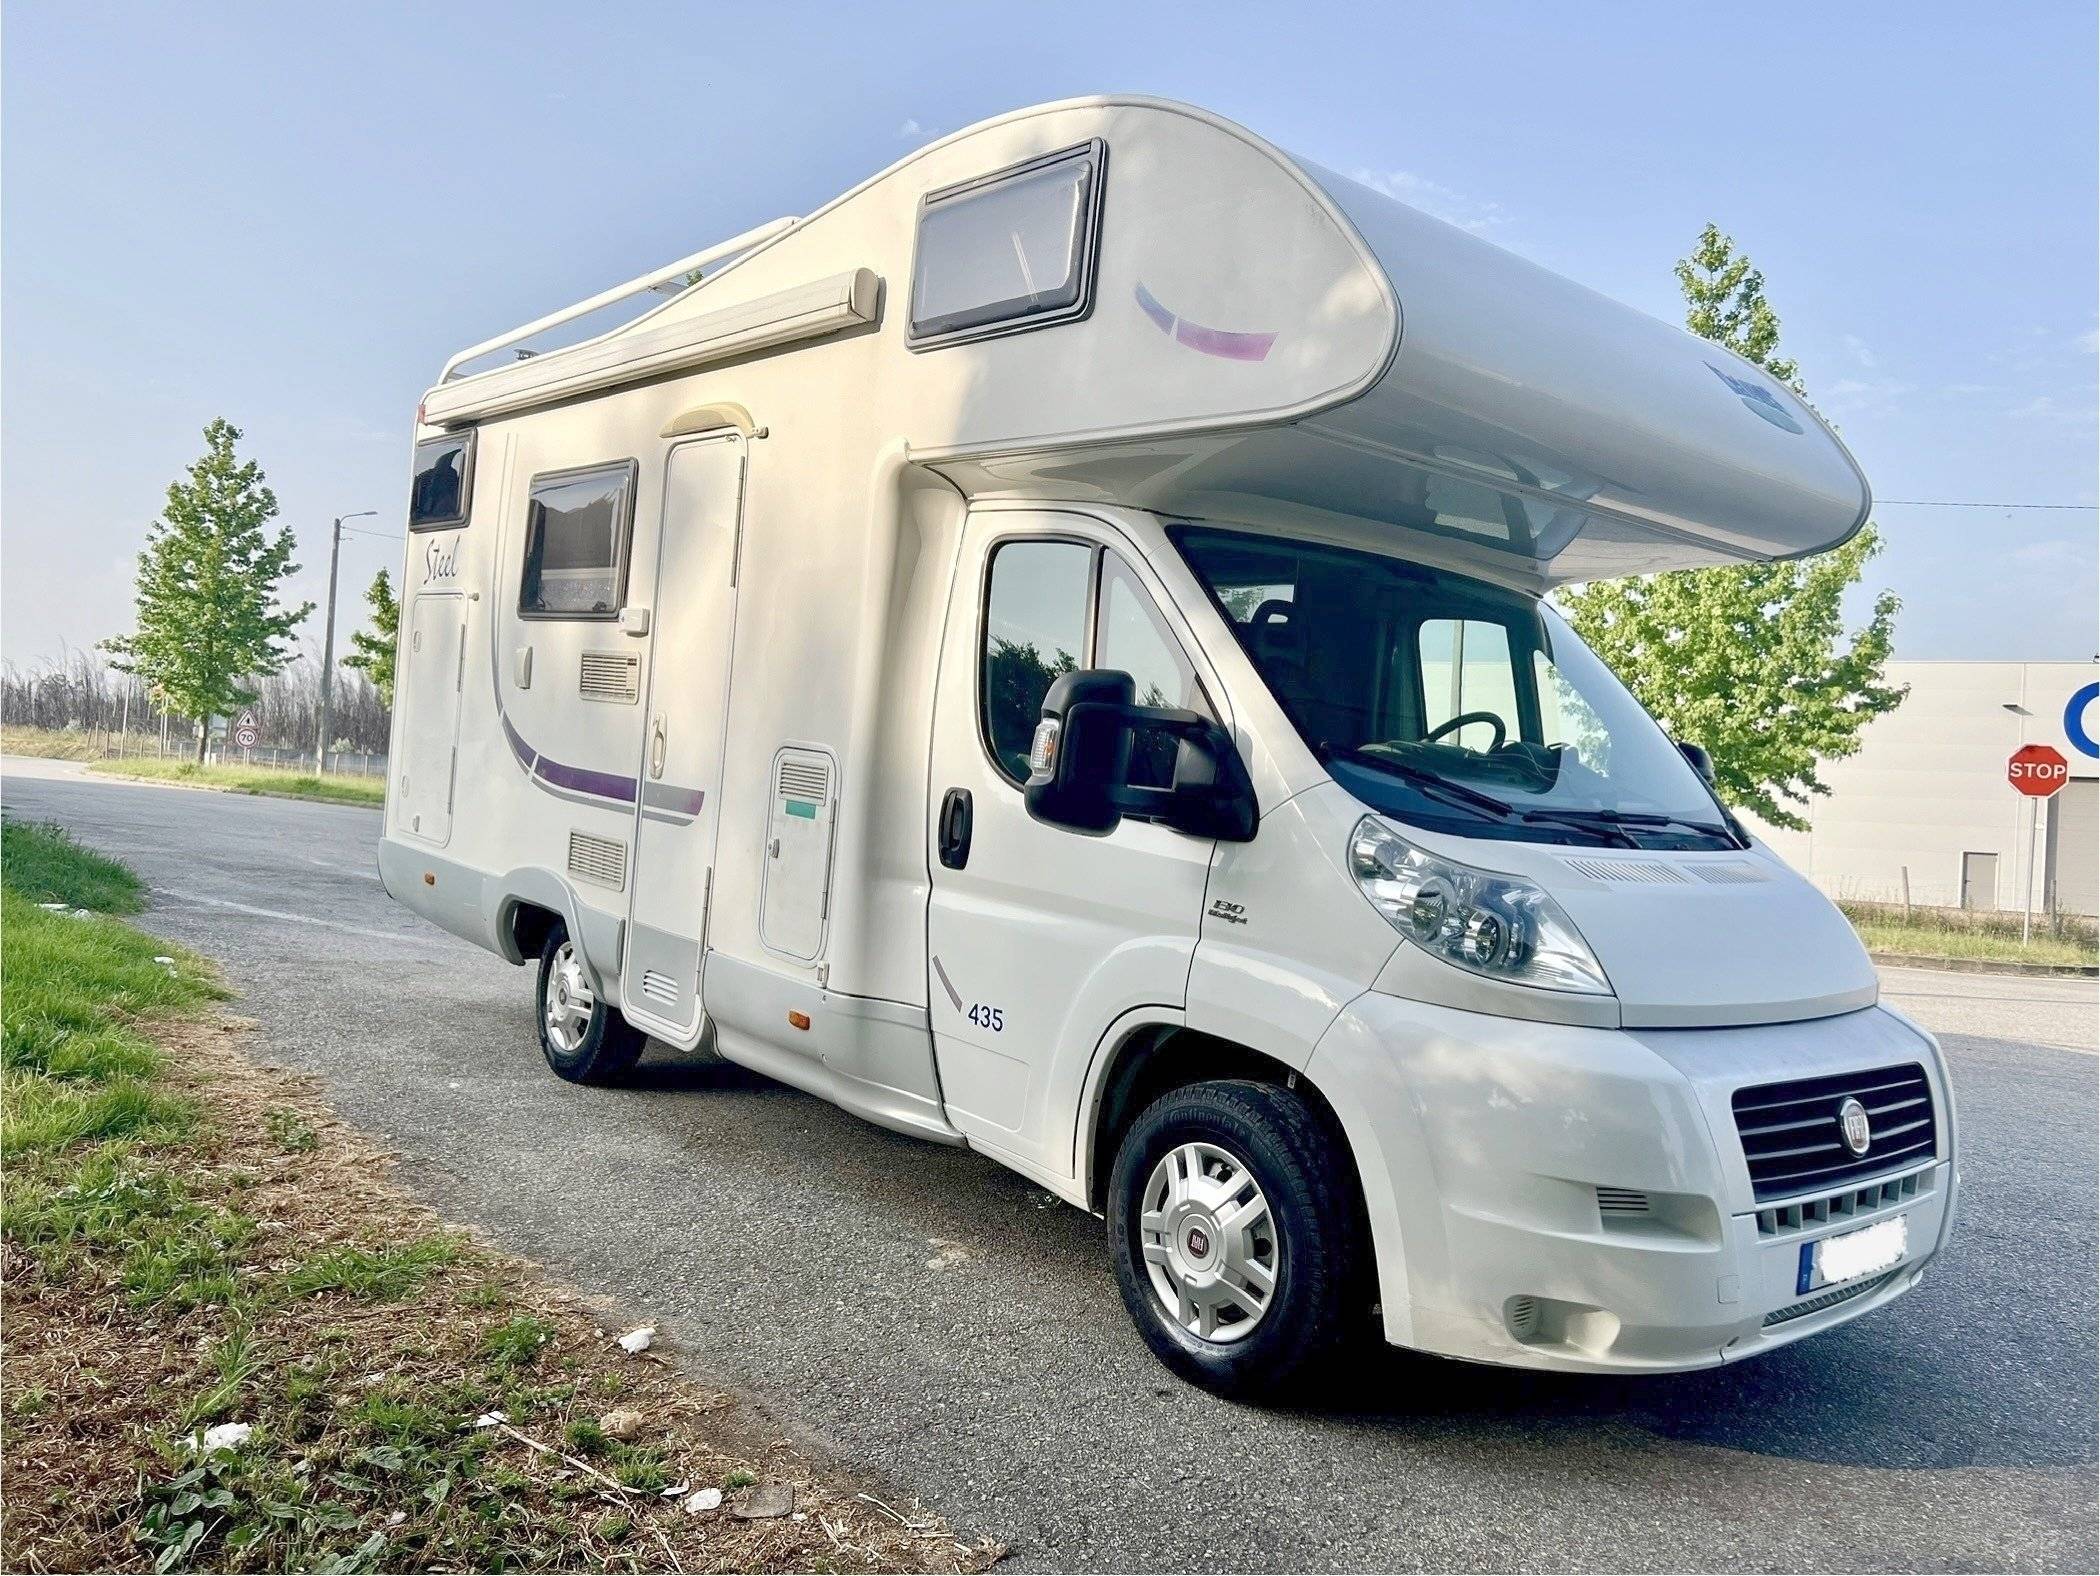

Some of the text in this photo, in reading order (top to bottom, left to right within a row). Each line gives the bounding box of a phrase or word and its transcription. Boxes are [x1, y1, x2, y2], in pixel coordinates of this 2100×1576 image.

[423, 534, 460, 585] Steel
[241, 733, 254, 742] 70
[2010, 762, 2066, 779] STOP
[967, 1003, 1003, 1032] 435
